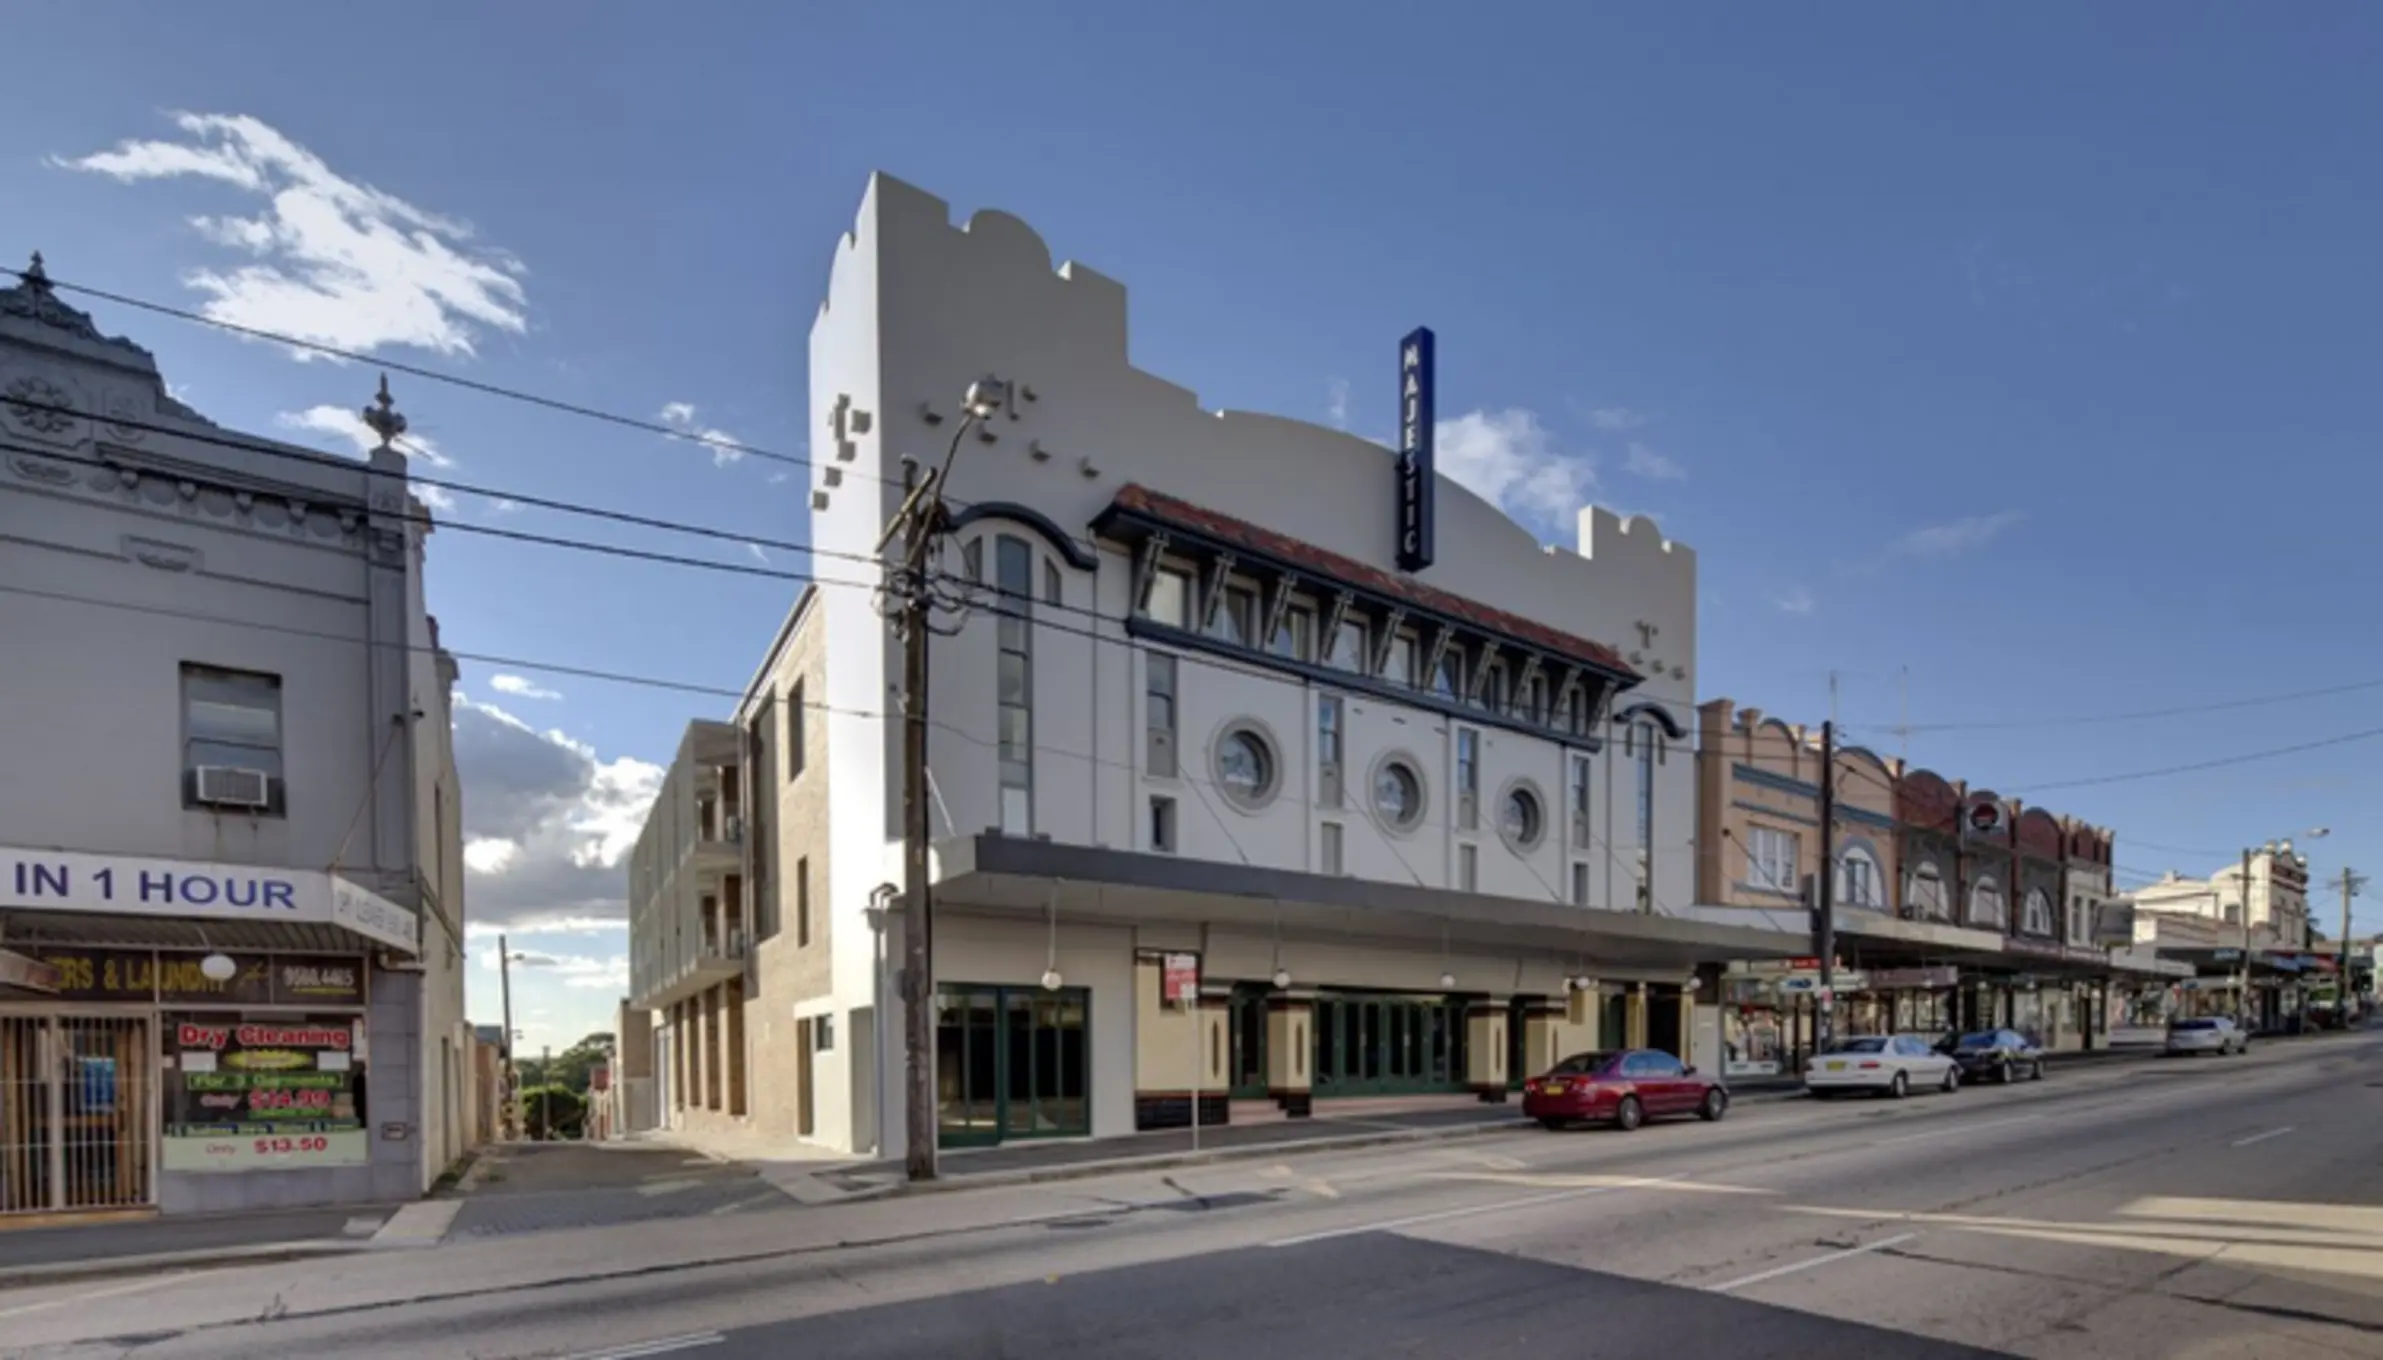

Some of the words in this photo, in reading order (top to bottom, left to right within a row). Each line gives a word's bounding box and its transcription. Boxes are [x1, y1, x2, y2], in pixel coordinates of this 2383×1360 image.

[1403, 343, 1419, 554] MAJESTIC
[15, 861, 68, 897] IN
[92, 867, 112, 900] 1
[139, 870, 297, 909] HOUR
[103, 959, 120, 990] &
[179, 1023, 228, 1049] Dry
[237, 1023, 350, 1049] Cleaning
